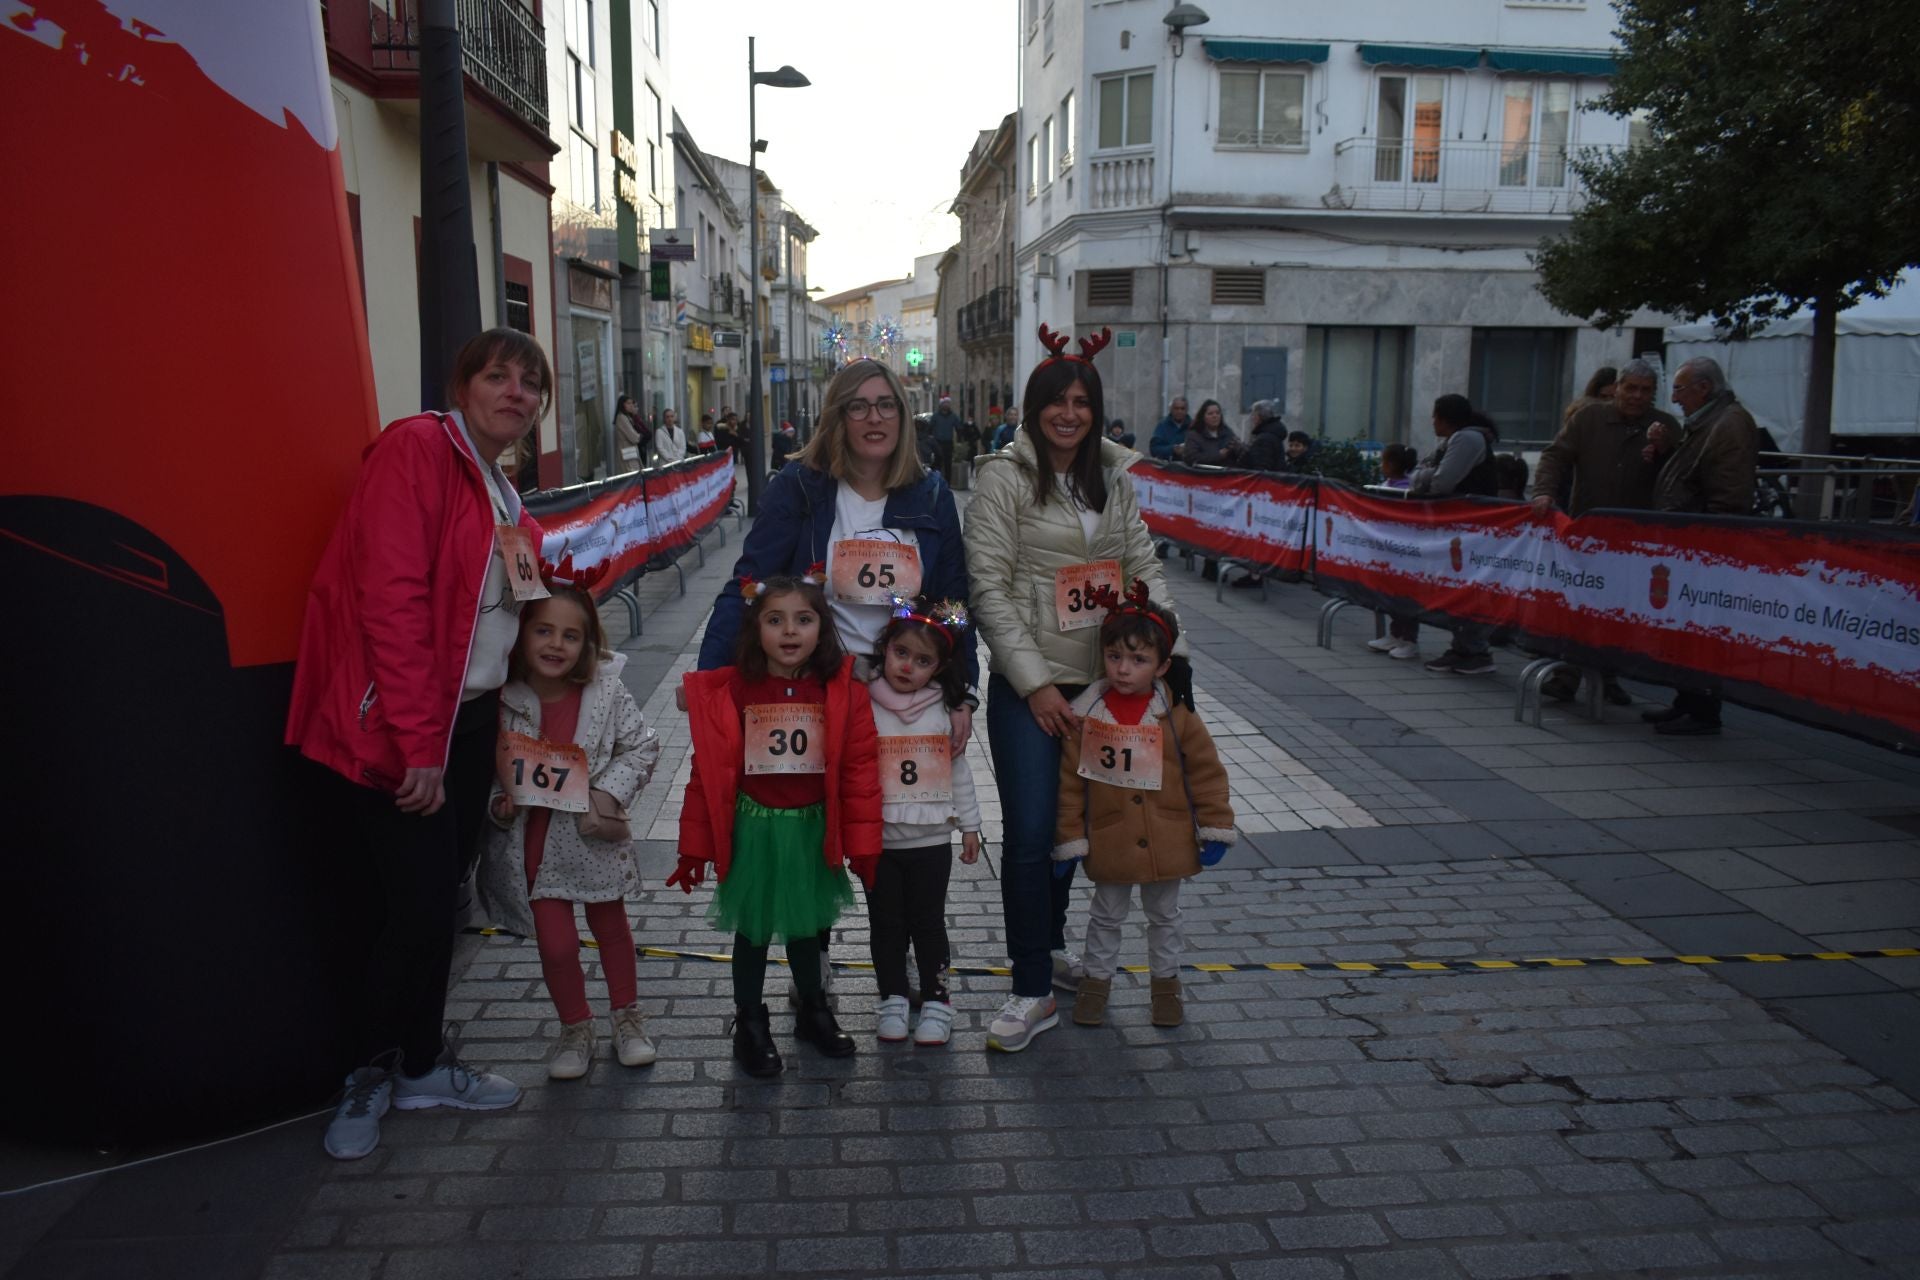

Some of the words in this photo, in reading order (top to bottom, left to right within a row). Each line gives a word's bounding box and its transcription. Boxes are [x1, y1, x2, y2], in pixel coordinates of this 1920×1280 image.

[516, 553, 532, 581] 66
[858, 563, 895, 588] 65
[1679, 583, 1790, 619] Ayuntamiento
[1795, 604, 1817, 625] de
[1822, 606, 1920, 646] Miajadas
[769, 729, 808, 756] 30
[1100, 745, 1132, 772] 31
[512, 758, 570, 792] 167
[900, 760, 918, 785] 8
